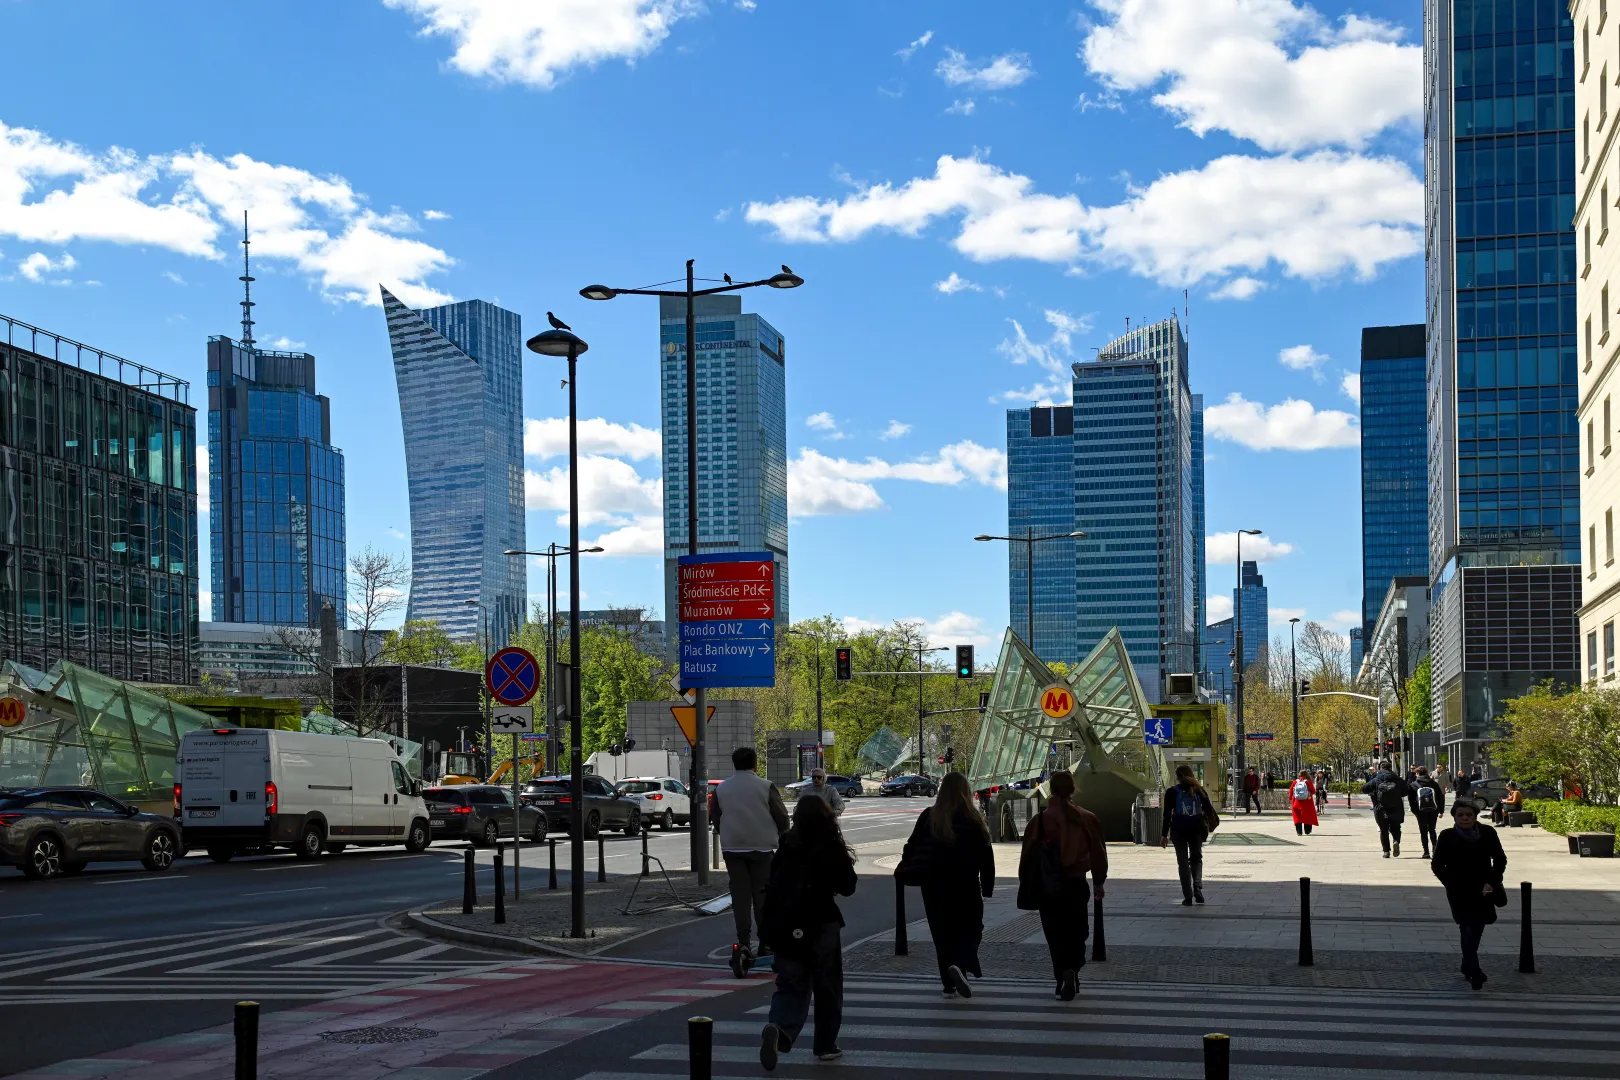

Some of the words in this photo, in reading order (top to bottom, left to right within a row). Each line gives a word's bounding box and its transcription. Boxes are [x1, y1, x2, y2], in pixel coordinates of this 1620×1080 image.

[679, 340, 751, 351] INRCONTINENTAL
[683, 567, 715, 580] Mirów
[683, 583, 740, 599] Śródmieście
[744, 584, 760, 596] Pd.
[684, 605, 734, 617] Muranów
[684, 625, 716, 636] Rondo
[718, 623, 743, 634] ONZ
[684, 645, 702, 656] Plac
[706, 644, 754, 658] Bankowy
[684, 662, 717, 672] Ratusz
